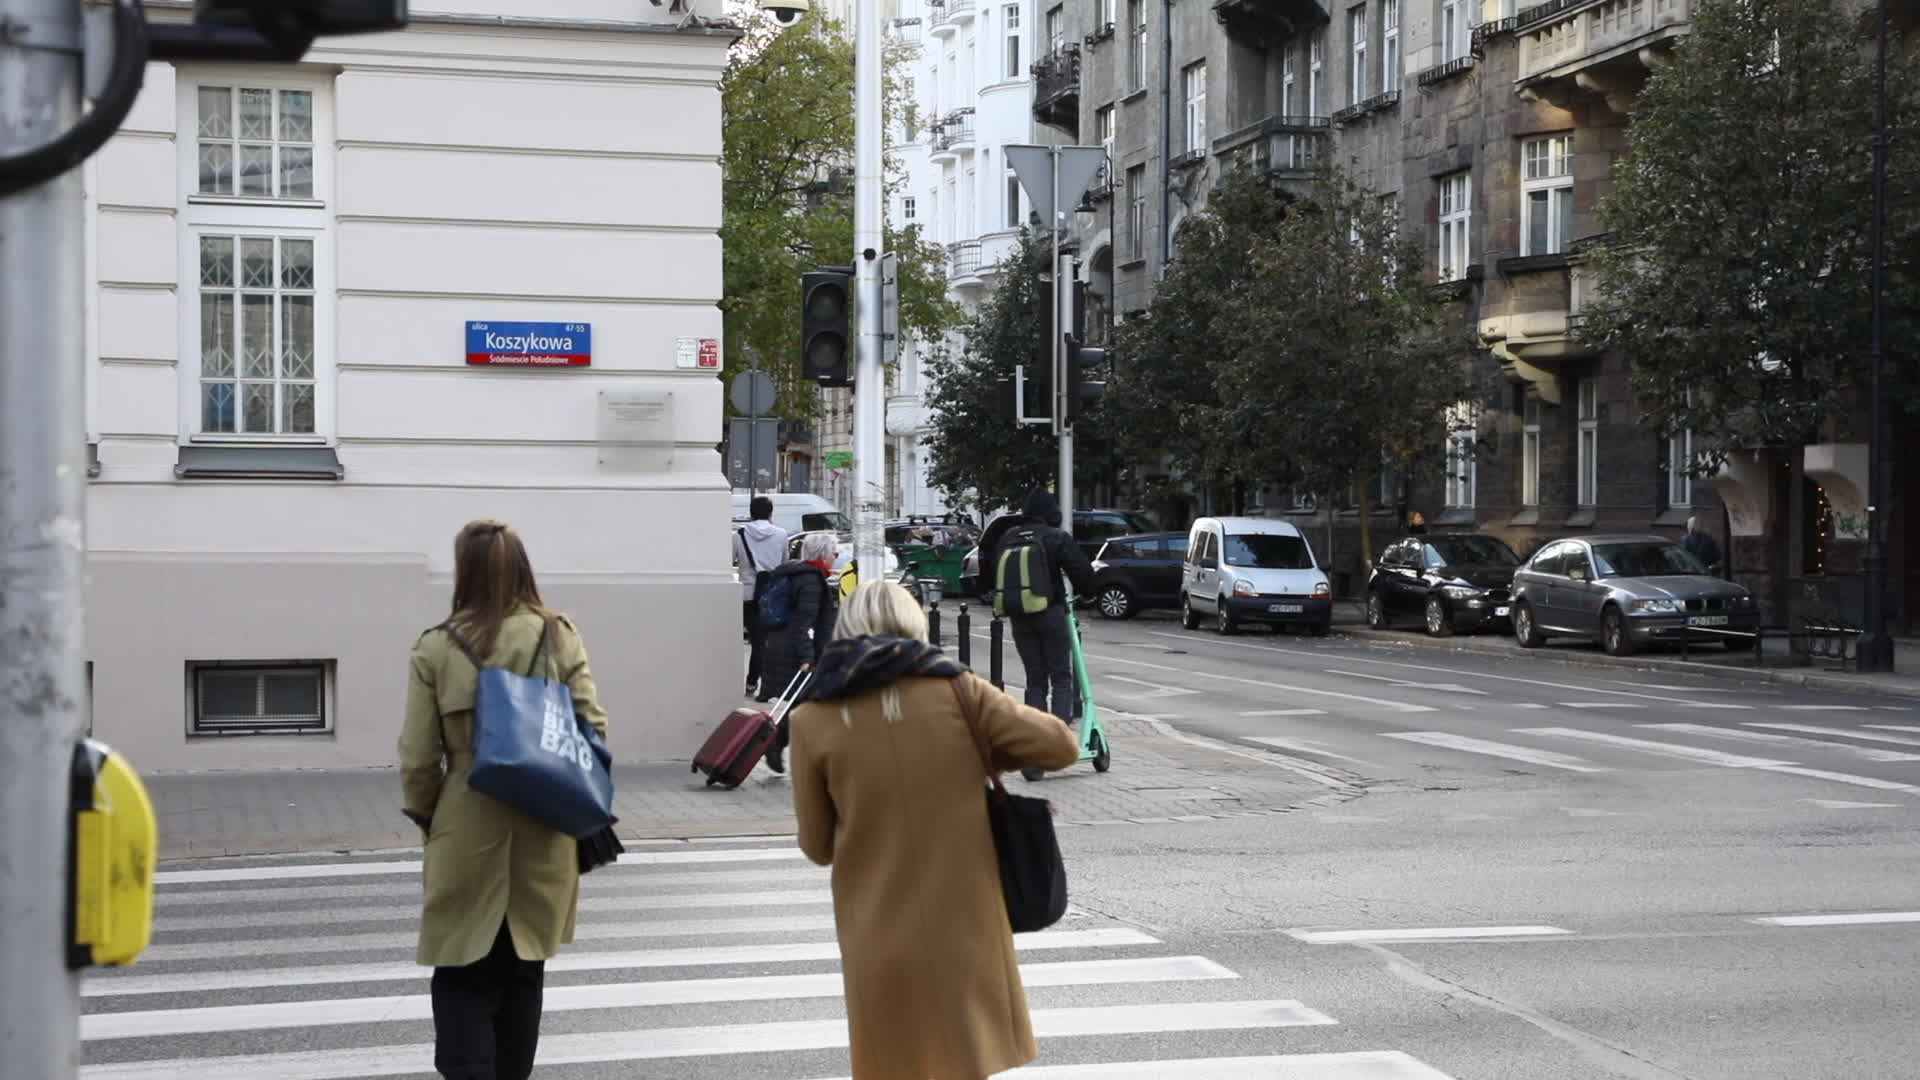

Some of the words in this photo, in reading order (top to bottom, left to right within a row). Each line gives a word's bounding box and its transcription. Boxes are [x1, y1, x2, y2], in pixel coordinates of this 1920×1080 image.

[472, 322, 488, 330] ulica
[486, 332, 573, 354] Koszykowa
[541, 728, 593, 770] BAG
